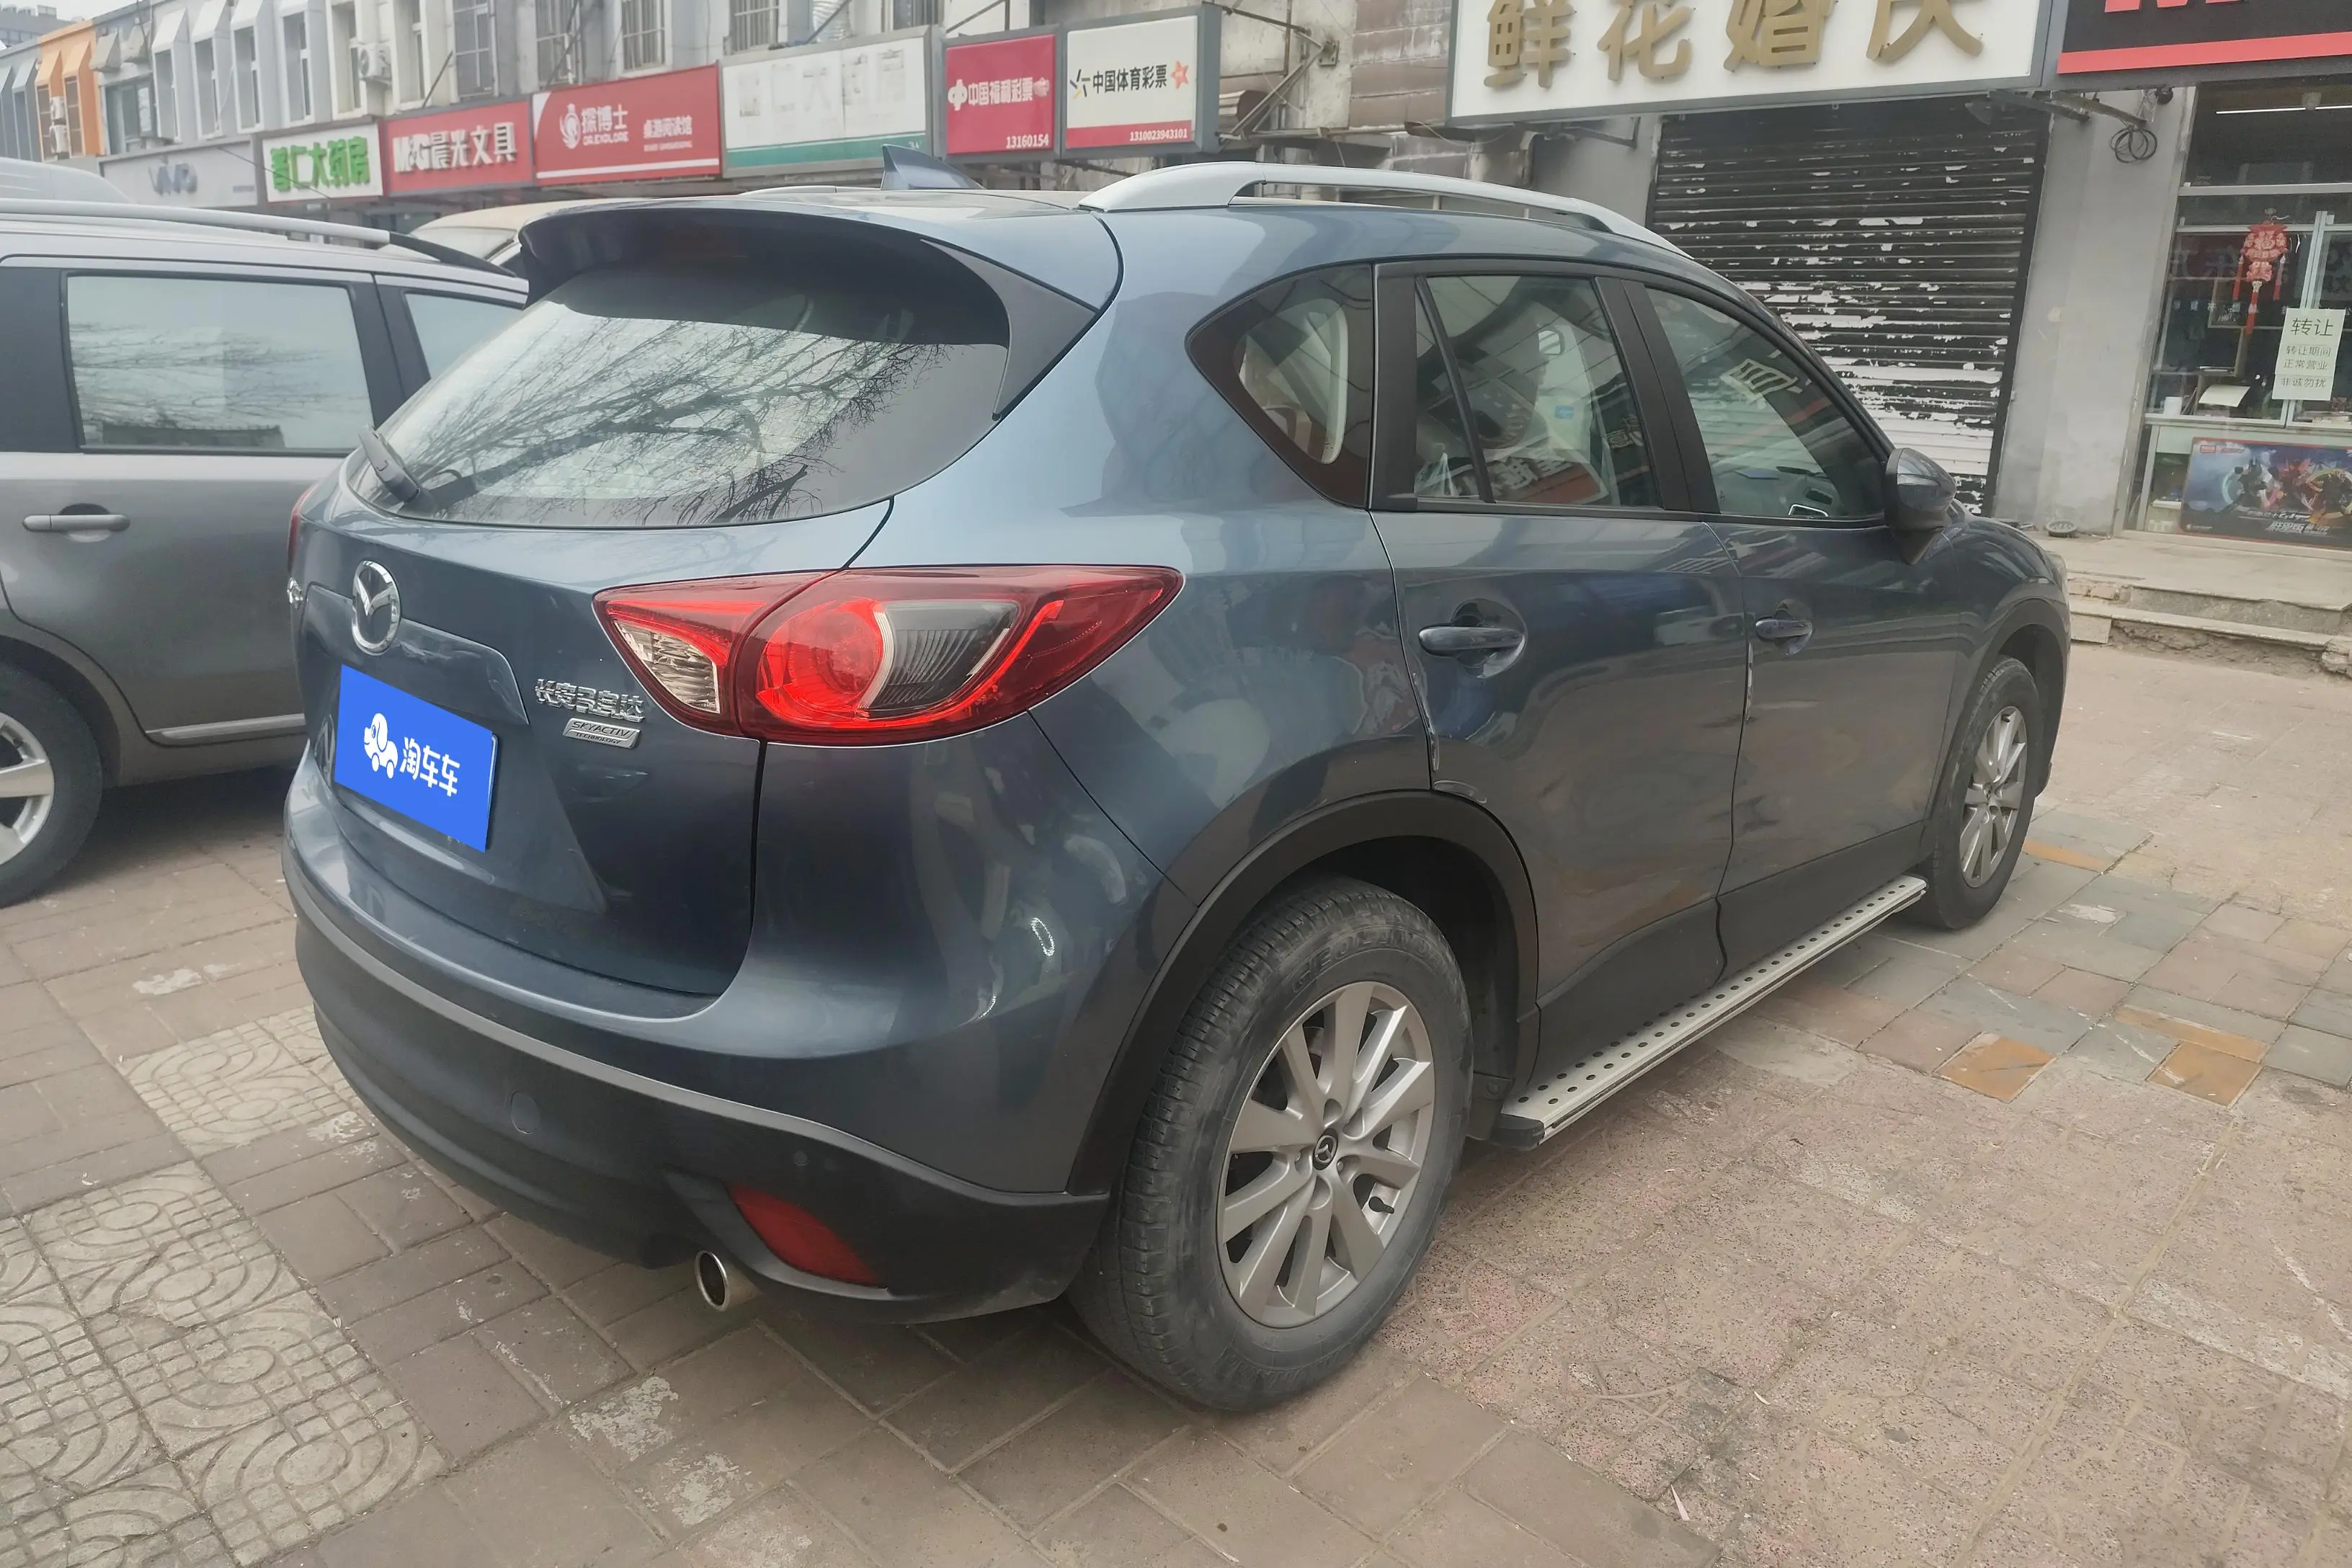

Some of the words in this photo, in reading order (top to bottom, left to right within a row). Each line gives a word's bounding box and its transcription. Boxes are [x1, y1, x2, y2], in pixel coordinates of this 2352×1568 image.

[1092, 64, 1167, 94] 中国体育彩票
[968, 76, 1033, 106] 中国福利彩票
[1006, 133, 1049, 150] 13160154
[1129, 127, 1188, 142] 1310023943101
[2291, 317, 2334, 337] 转让
[2286, 345, 2332, 357] 转让期间
[2283, 359, 2328, 370] 正常营业
[2280, 377, 2327, 388] 非诚勿扰
[535, 678, 645, 723] 长安马自达
[571, 721, 631, 738] SKYACTIV
[576, 732, 622, 745] TECHNOLOGY
